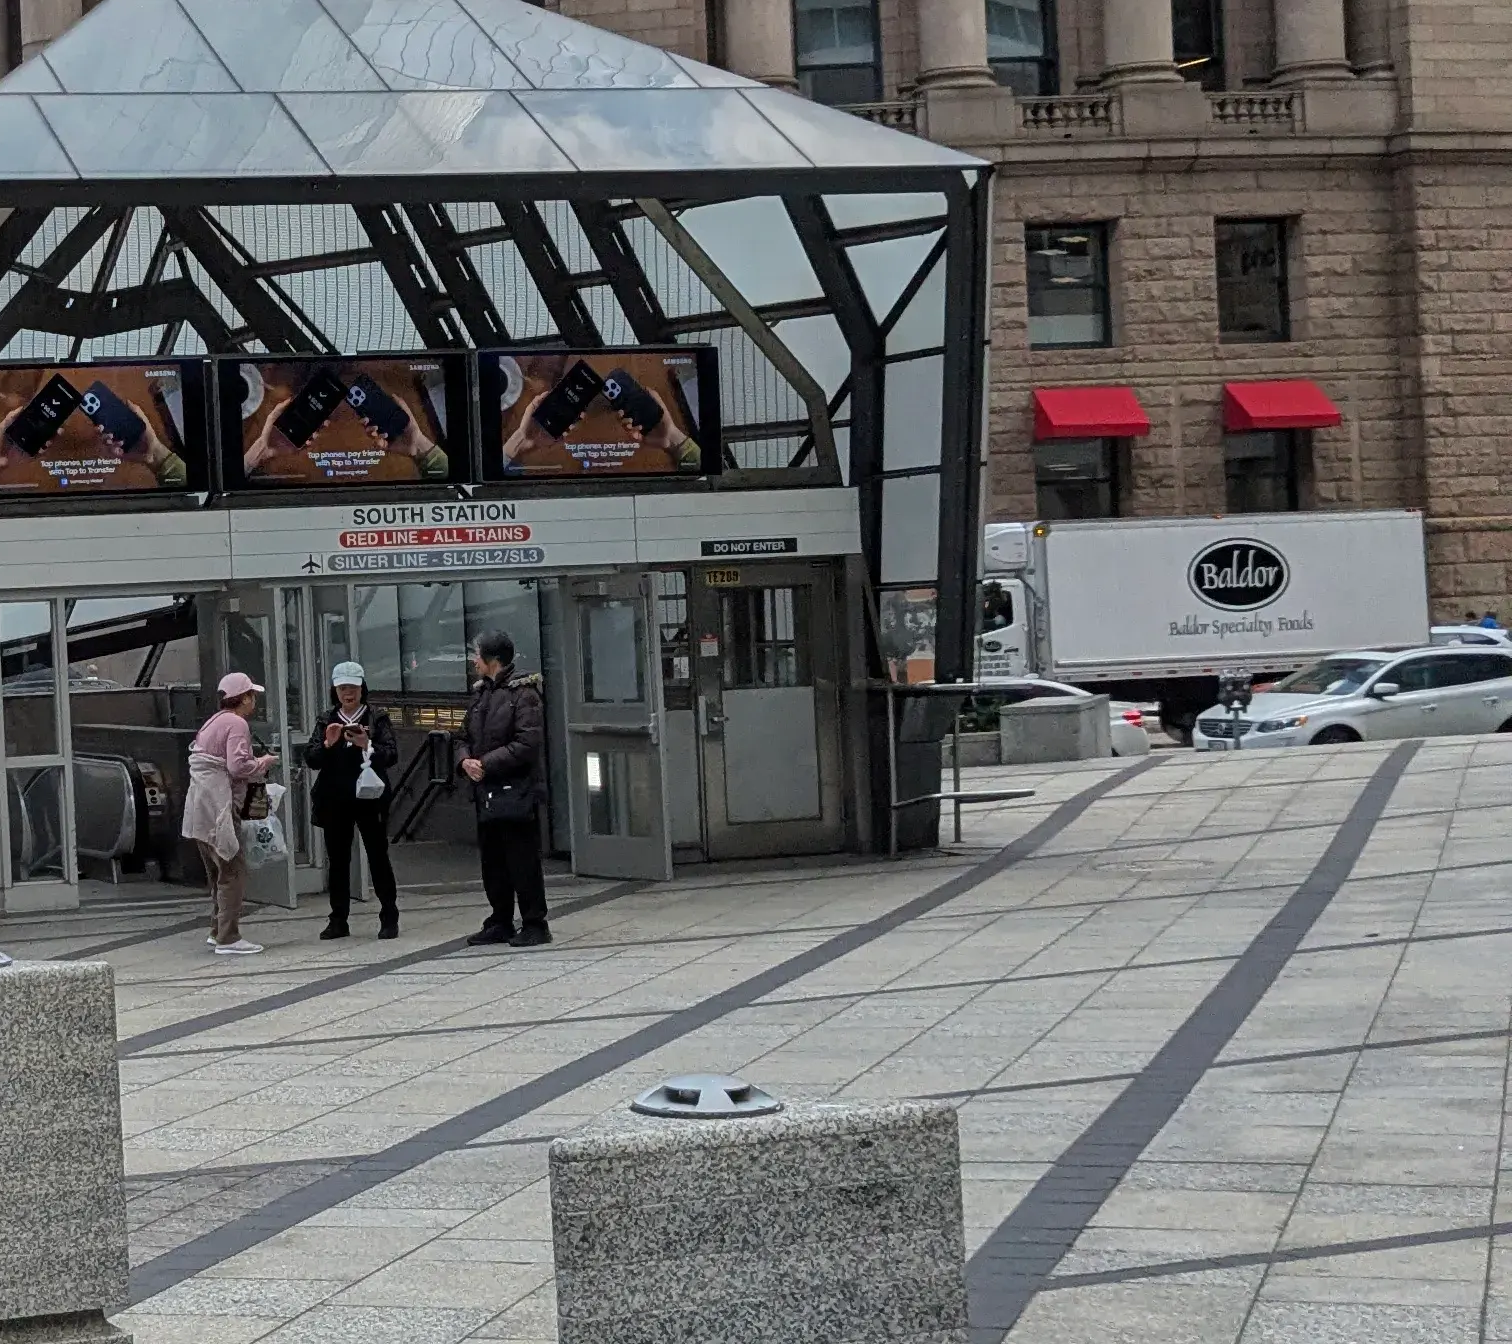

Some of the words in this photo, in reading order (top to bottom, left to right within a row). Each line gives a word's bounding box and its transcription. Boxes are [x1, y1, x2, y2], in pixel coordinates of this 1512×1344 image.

[353, 507, 424, 525] SOUTH
[431, 503, 516, 523] STATION
[346, 532, 379, 546] RED
[384, 530, 419, 545] LINE
[433, 528, 463, 543] ALL
[465, 527, 524, 542] TRAINS
[713, 543, 728, 553] DO
[730, 542, 751, 552] NOT
[753, 541, 786, 551] ENTER
[334, 554, 388, 569] SILVER
[393, 552, 428, 567] LINE
[442, 549, 538, 566] SL1/SL2/SL3
[1199, 549, 1280, 589] Baldor
[1169, 613, 1210, 636] Baldor
[1212, 612, 1273, 639] Specialty
[1278, 609, 1314, 631] Foods
